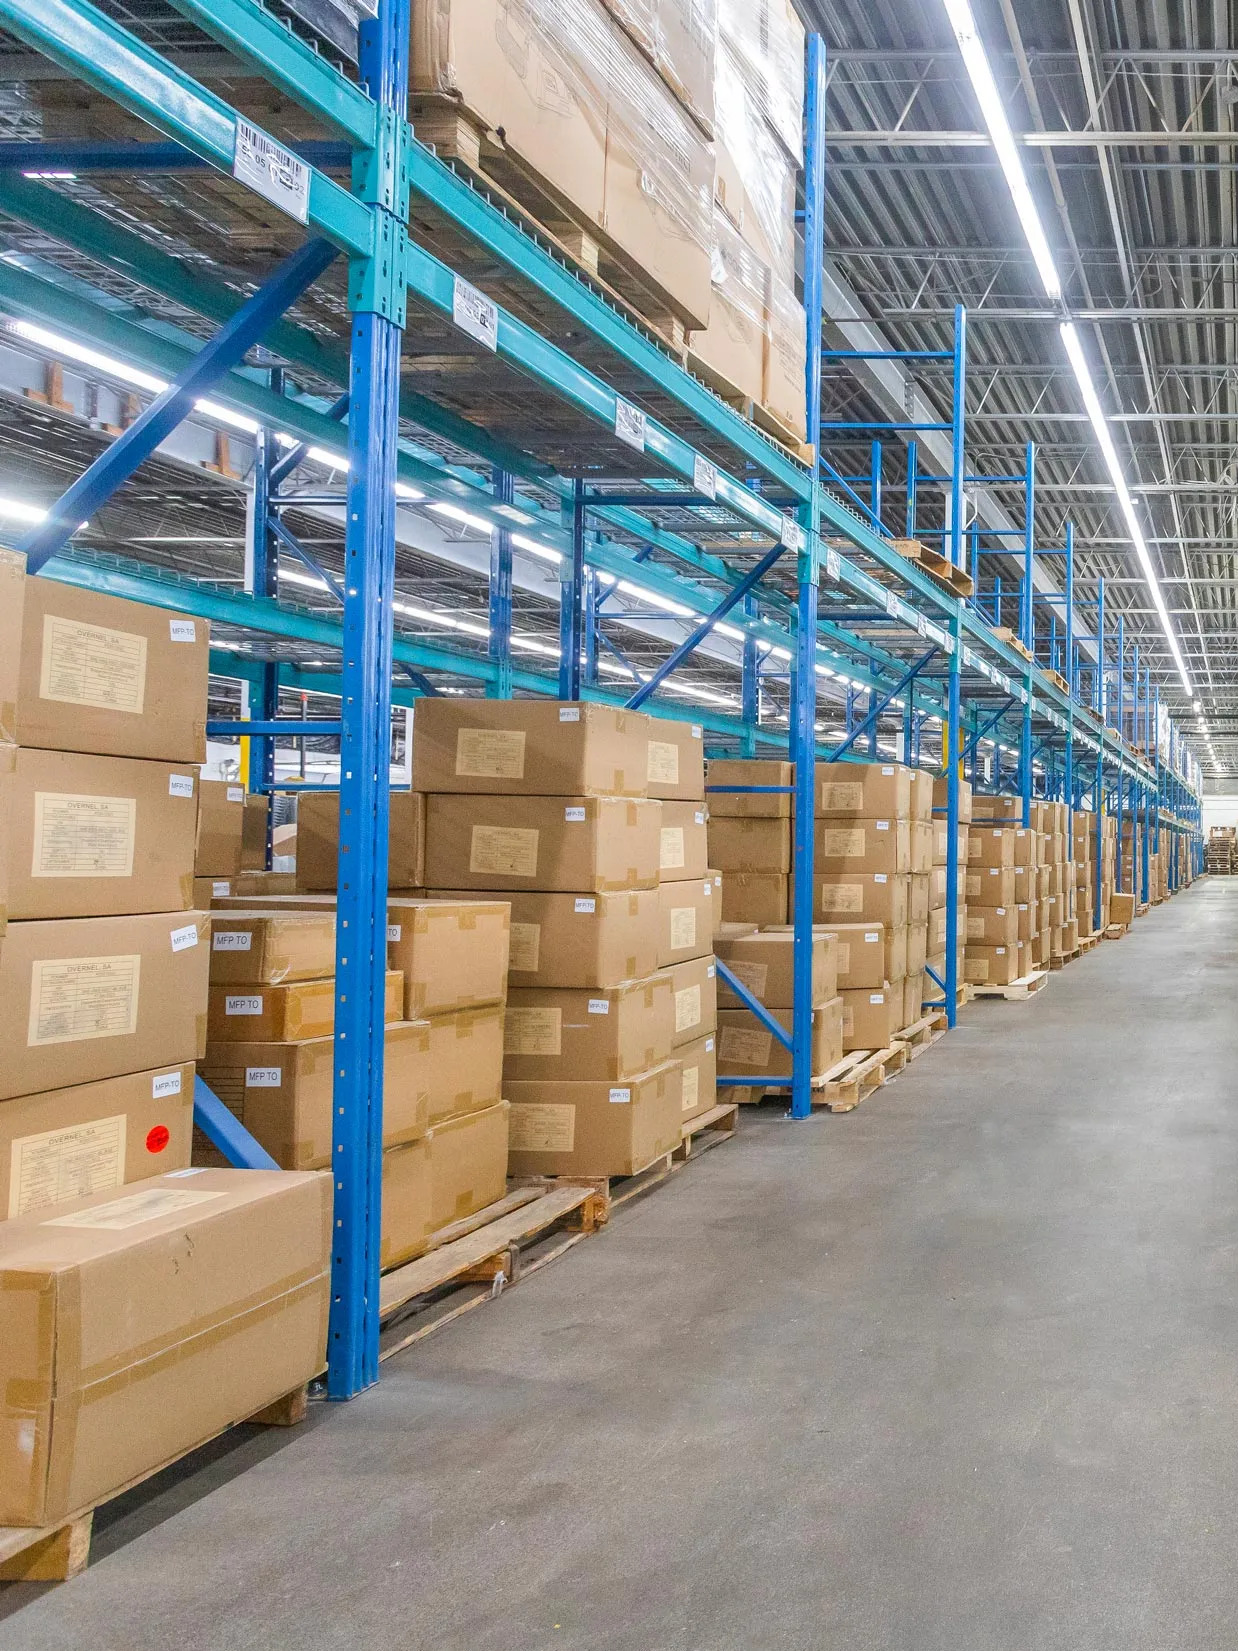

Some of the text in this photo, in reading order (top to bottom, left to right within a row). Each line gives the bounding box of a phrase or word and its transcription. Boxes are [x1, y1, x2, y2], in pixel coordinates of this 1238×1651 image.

[255, 154, 266, 168] 05
[172, 626, 195, 636] MFP-TO
[171, 782, 192, 791] MFP-TO
[173, 932, 196, 945] MFP-TO
[216, 935, 248, 945] MFP TO
[229, 1000, 259, 1009] MFP TO
[249, 1071, 278, 1081] MFP TO
[155, 1080, 179, 1091] MFP-TO
